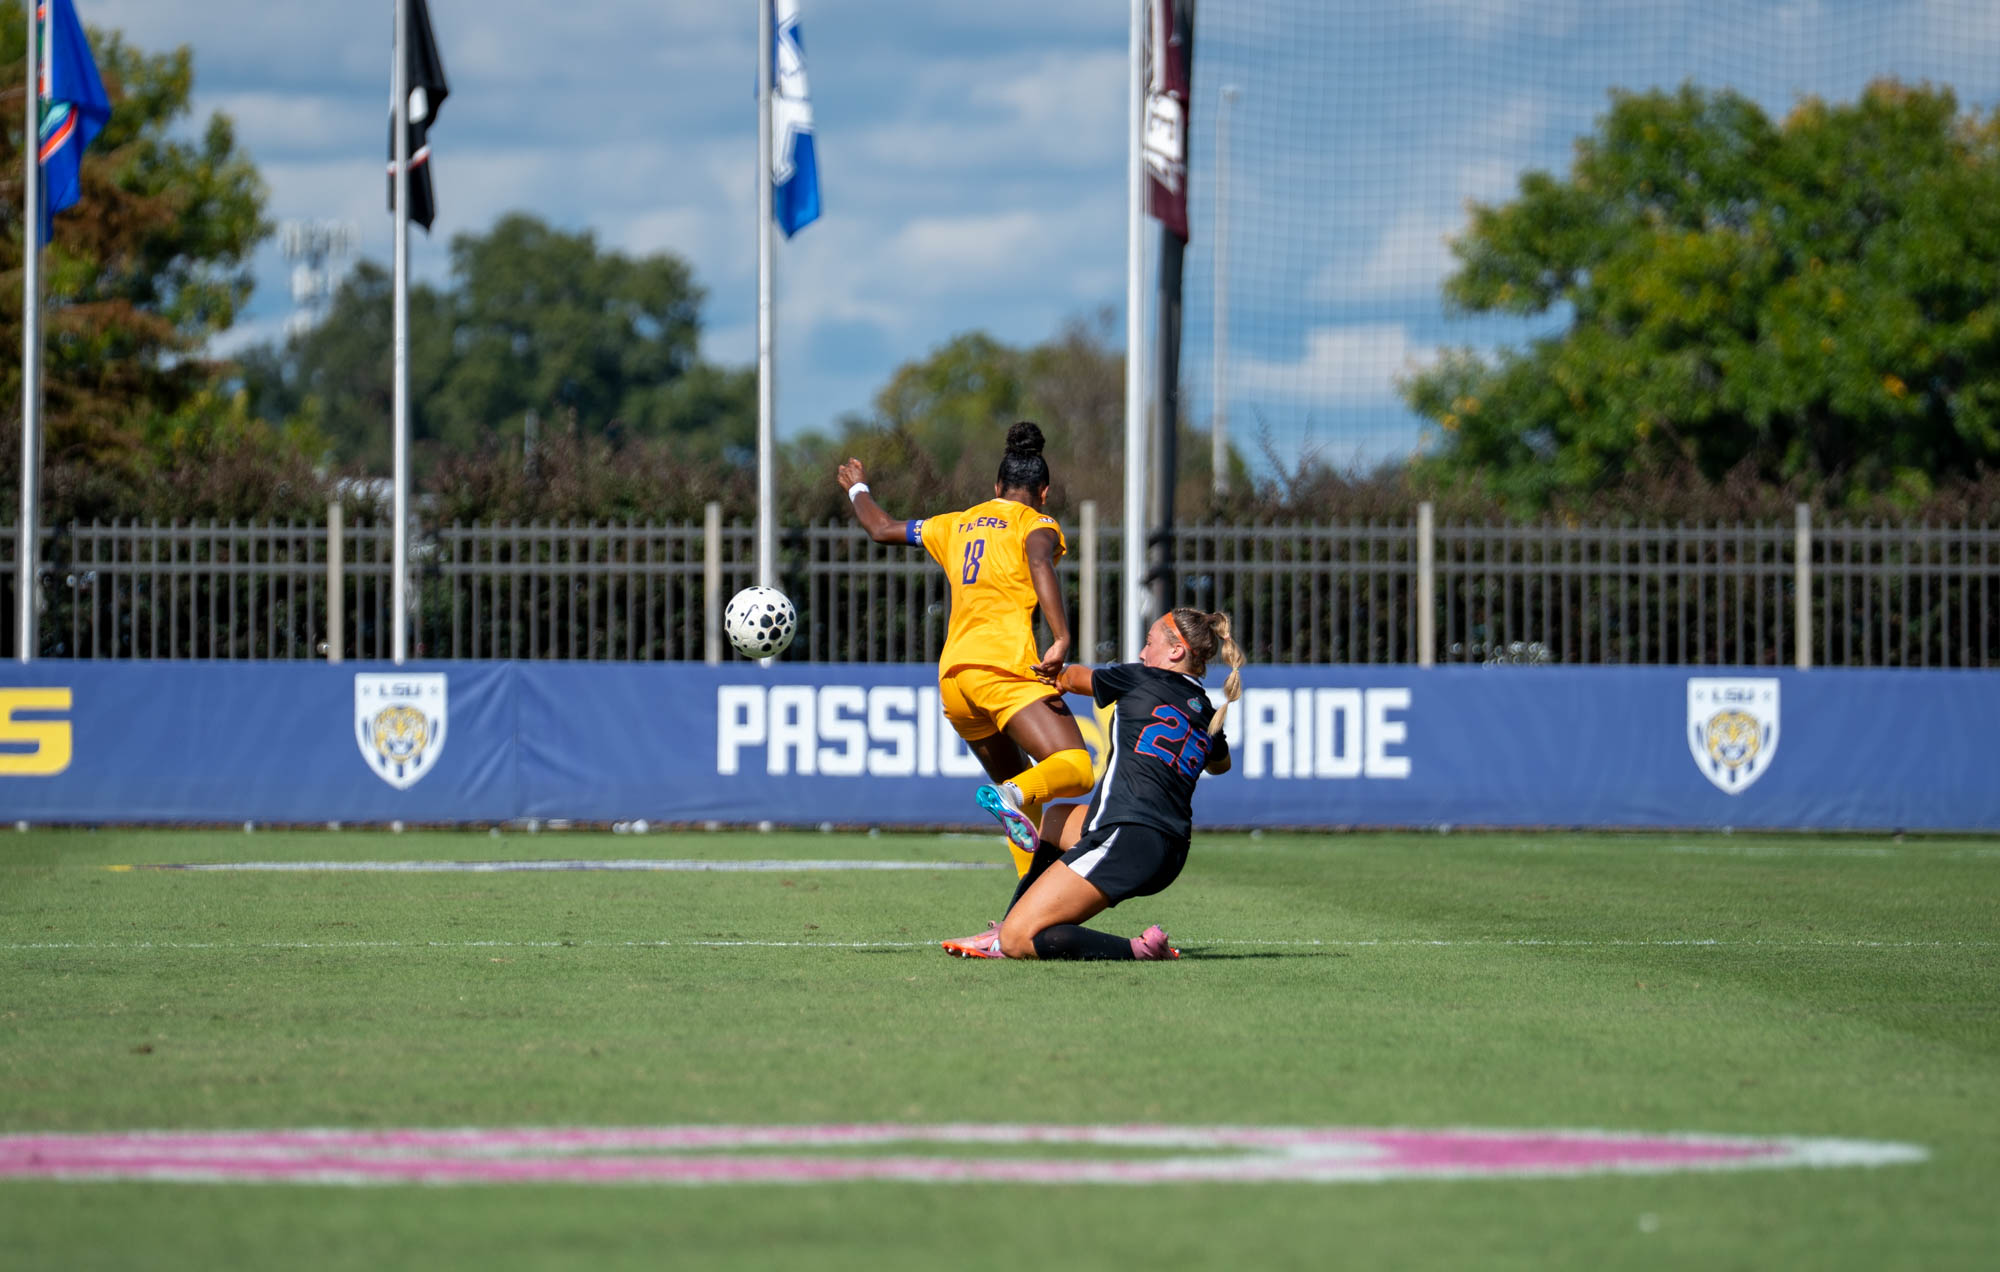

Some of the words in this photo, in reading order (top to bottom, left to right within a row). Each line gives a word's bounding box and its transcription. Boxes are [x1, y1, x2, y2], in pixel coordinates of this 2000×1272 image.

[958, 516, 1008, 534] TIERS
[962, 539, 985, 585] 18
[379, 683, 422, 697] LSU
[1711, 687, 1755, 702] LSU
[717, 685, 987, 777] PASSI
